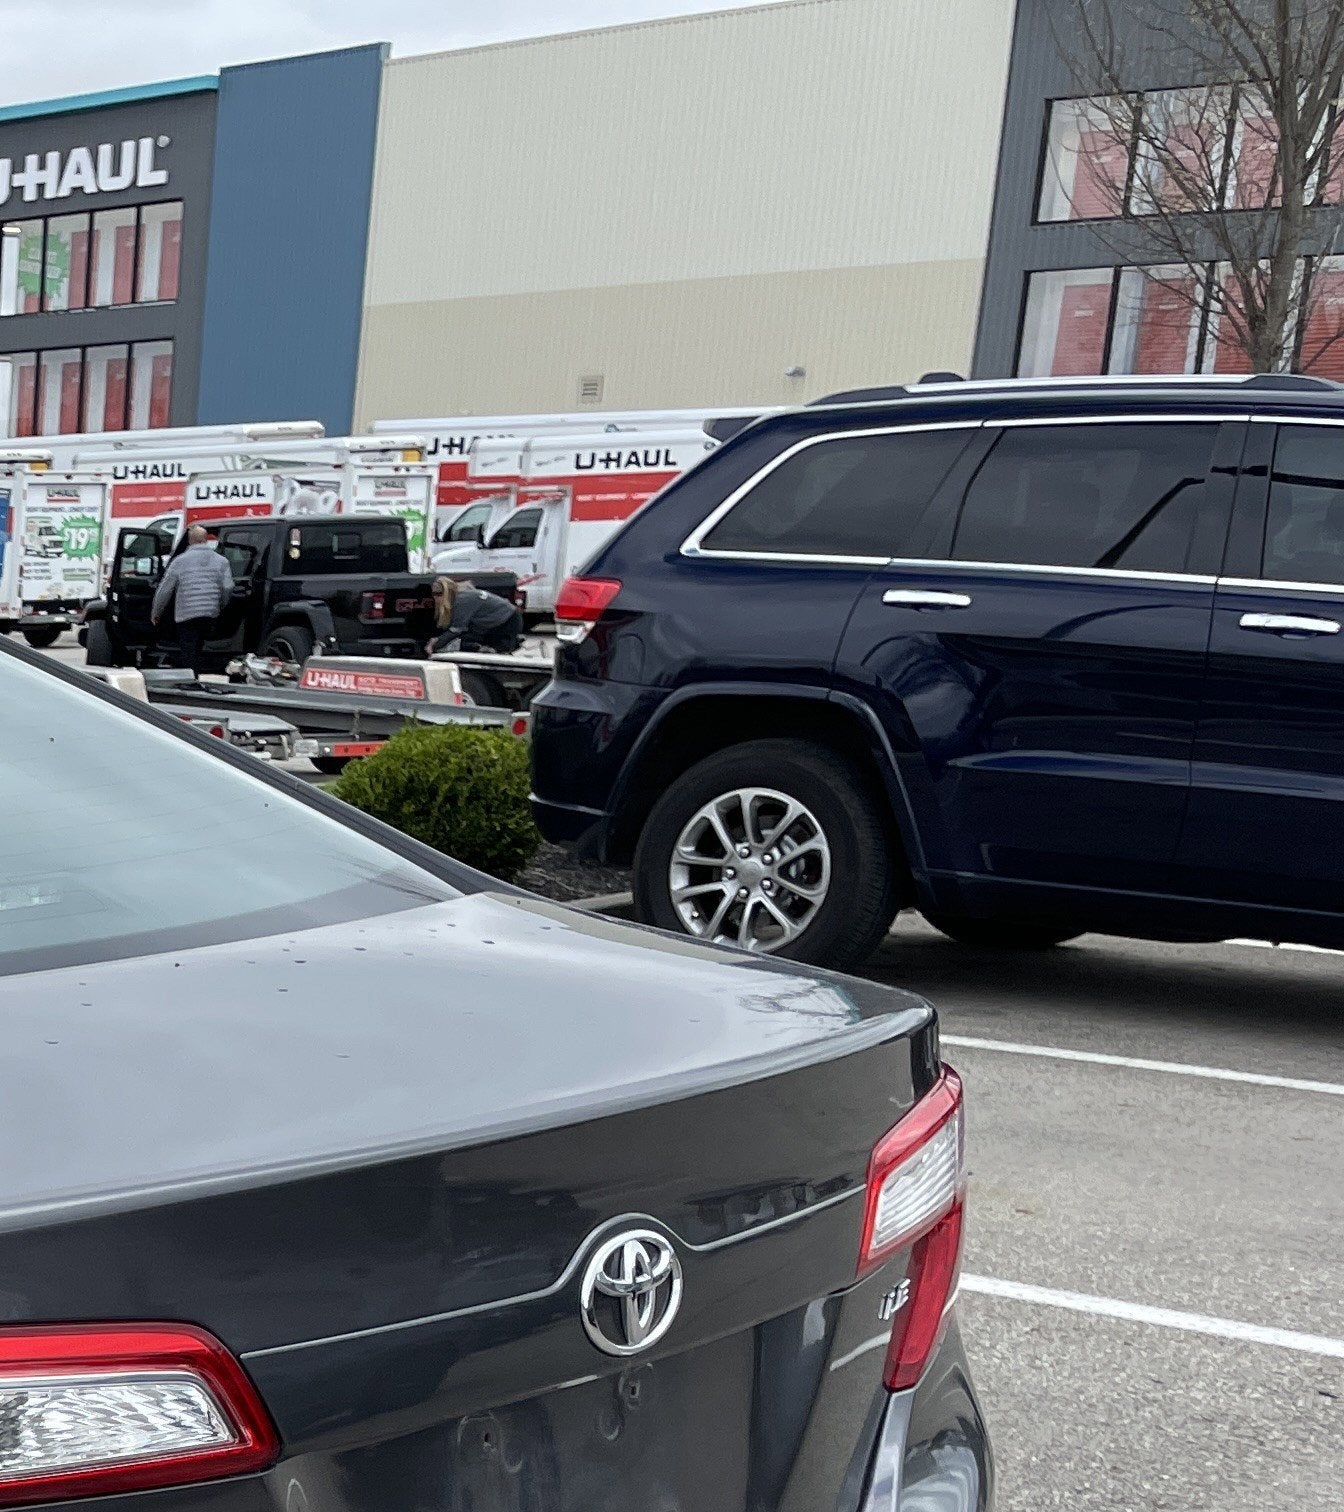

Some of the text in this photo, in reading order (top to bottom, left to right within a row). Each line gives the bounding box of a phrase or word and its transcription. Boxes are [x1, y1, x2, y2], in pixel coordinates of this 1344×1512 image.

[575, 449, 677, 469] U-HAUL
[112, 463, 187, 480] U-HAUL
[196, 483, 266, 500] U-HAUL
[877, 1278, 911, 1321] LE
